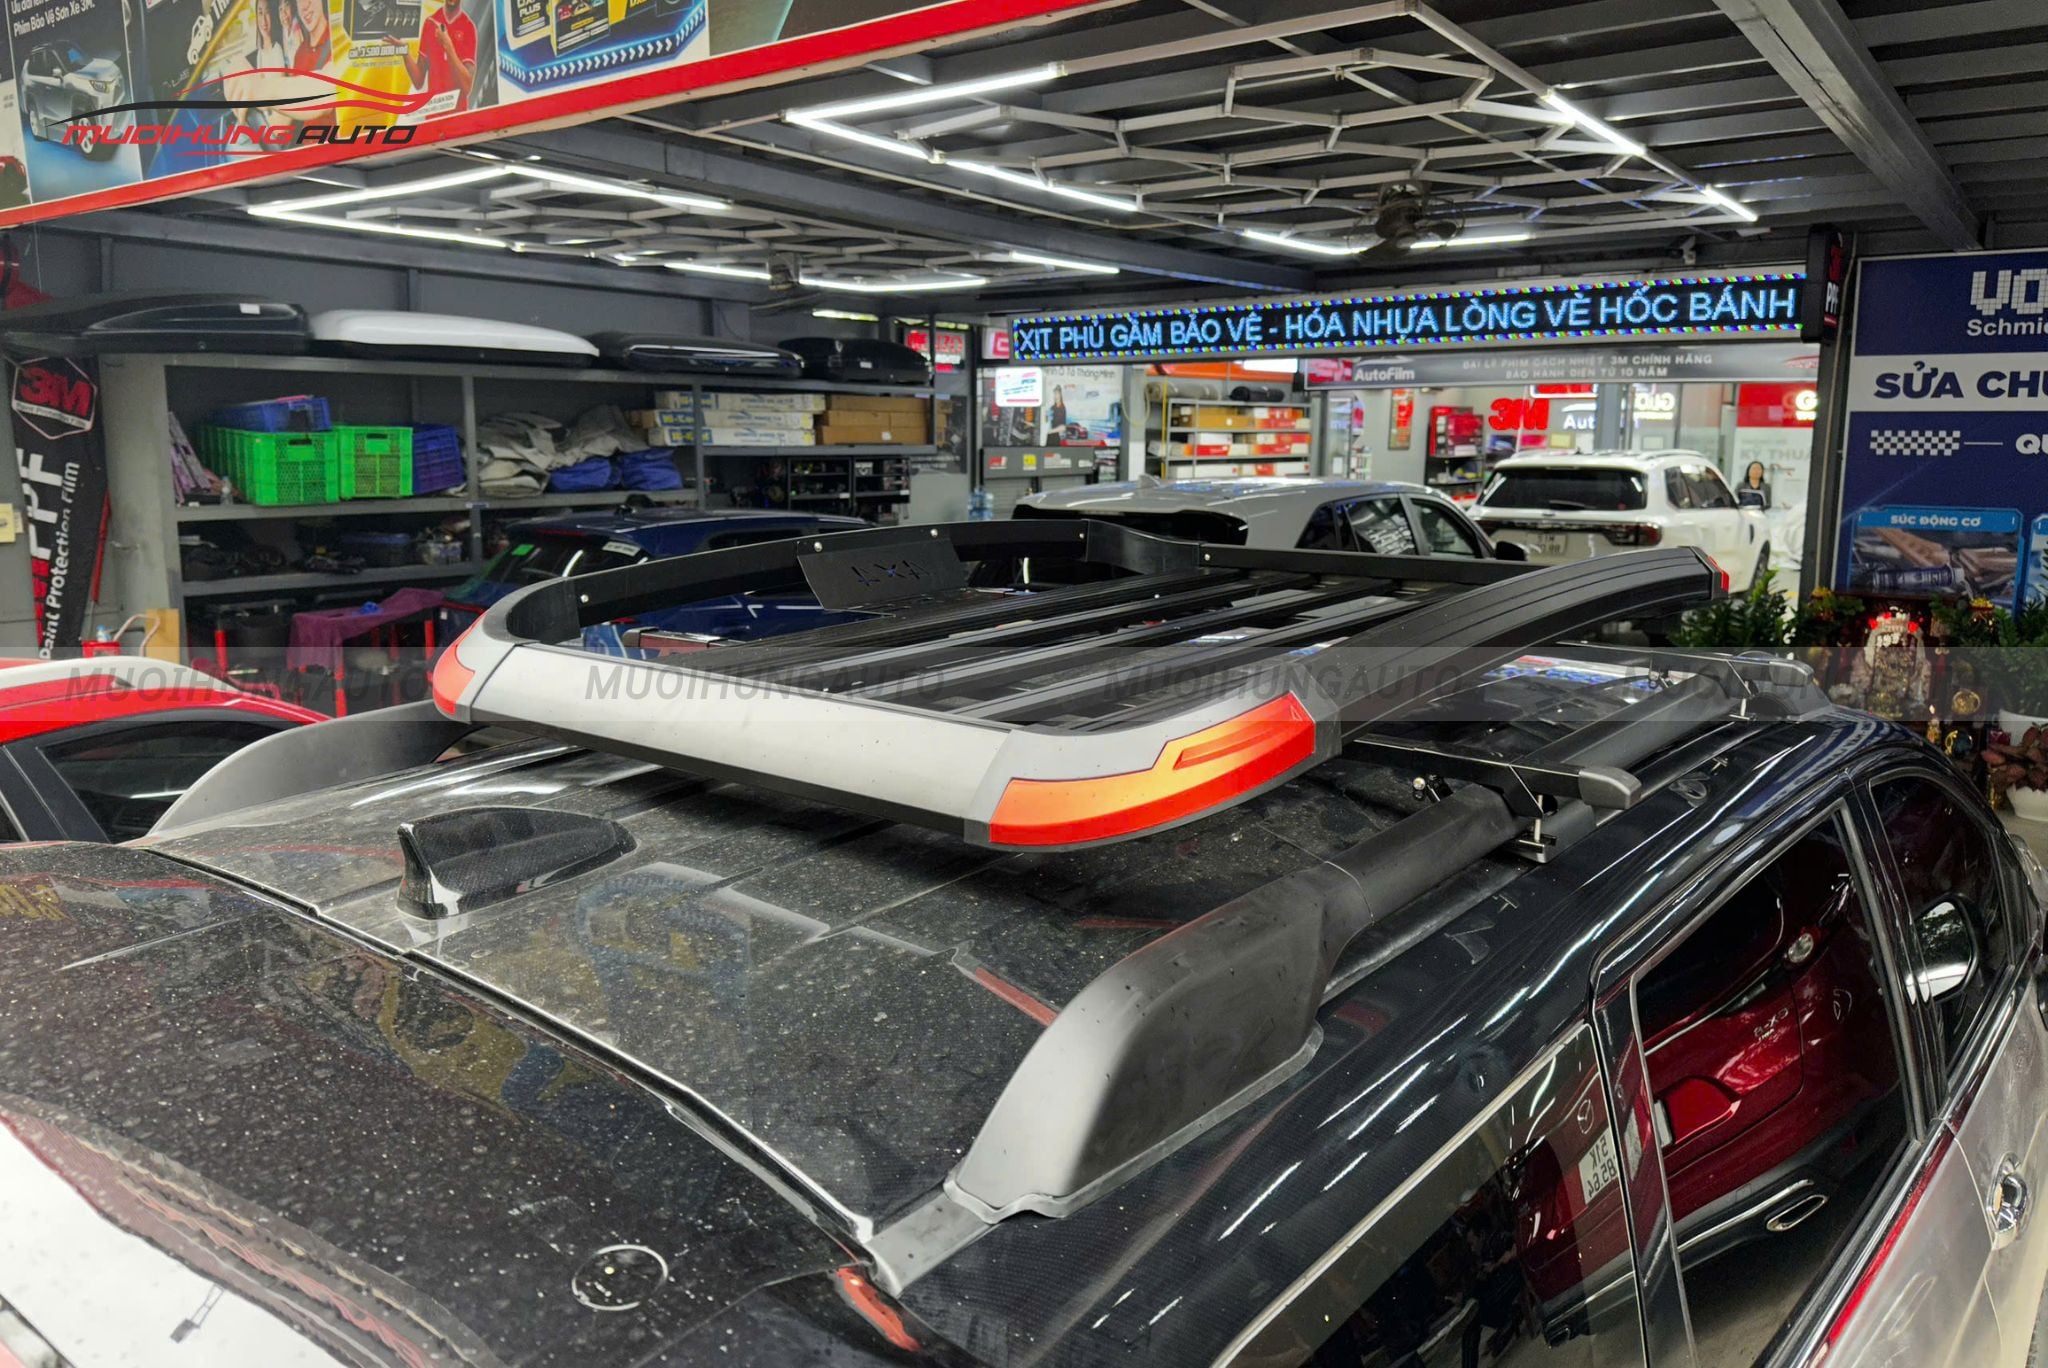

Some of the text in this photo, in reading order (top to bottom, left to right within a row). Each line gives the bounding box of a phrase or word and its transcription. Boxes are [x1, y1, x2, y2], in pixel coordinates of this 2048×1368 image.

[13, 20, 31, 37] Phim
[69, 1, 80, 16] Xe
[1019, 328, 1053, 356] XỊT
[1059, 320, 1104, 349] PHỦ
[1110, 316, 1163, 347] GẦM
[1170, 313, 1221, 345] BẢO
[1226, 312, 1263, 346] VỆ
[1285, 308, 1346, 339] HÓA
[1353, 306, 1439, 340] NHỰA
[1445, 298, 1537, 332] LÒNG
[1544, 293, 1592, 327] VÈ
[1600, 285, 1678, 324] HỐC
[1689, 285, 1796, 321] BÁNH
[1354, 366, 1416, 383] AutoFilm
[1611, 354, 1628, 366] 3M
[1632, 352, 1671, 365] CHÍNH
[20, 366, 92, 417] 3M
[1874, 361, 1965, 399] SỬA
[1488, 398, 1550, 430] 3M
[46, 509, 73, 609] Protection
[61, 461, 80, 503] Film
